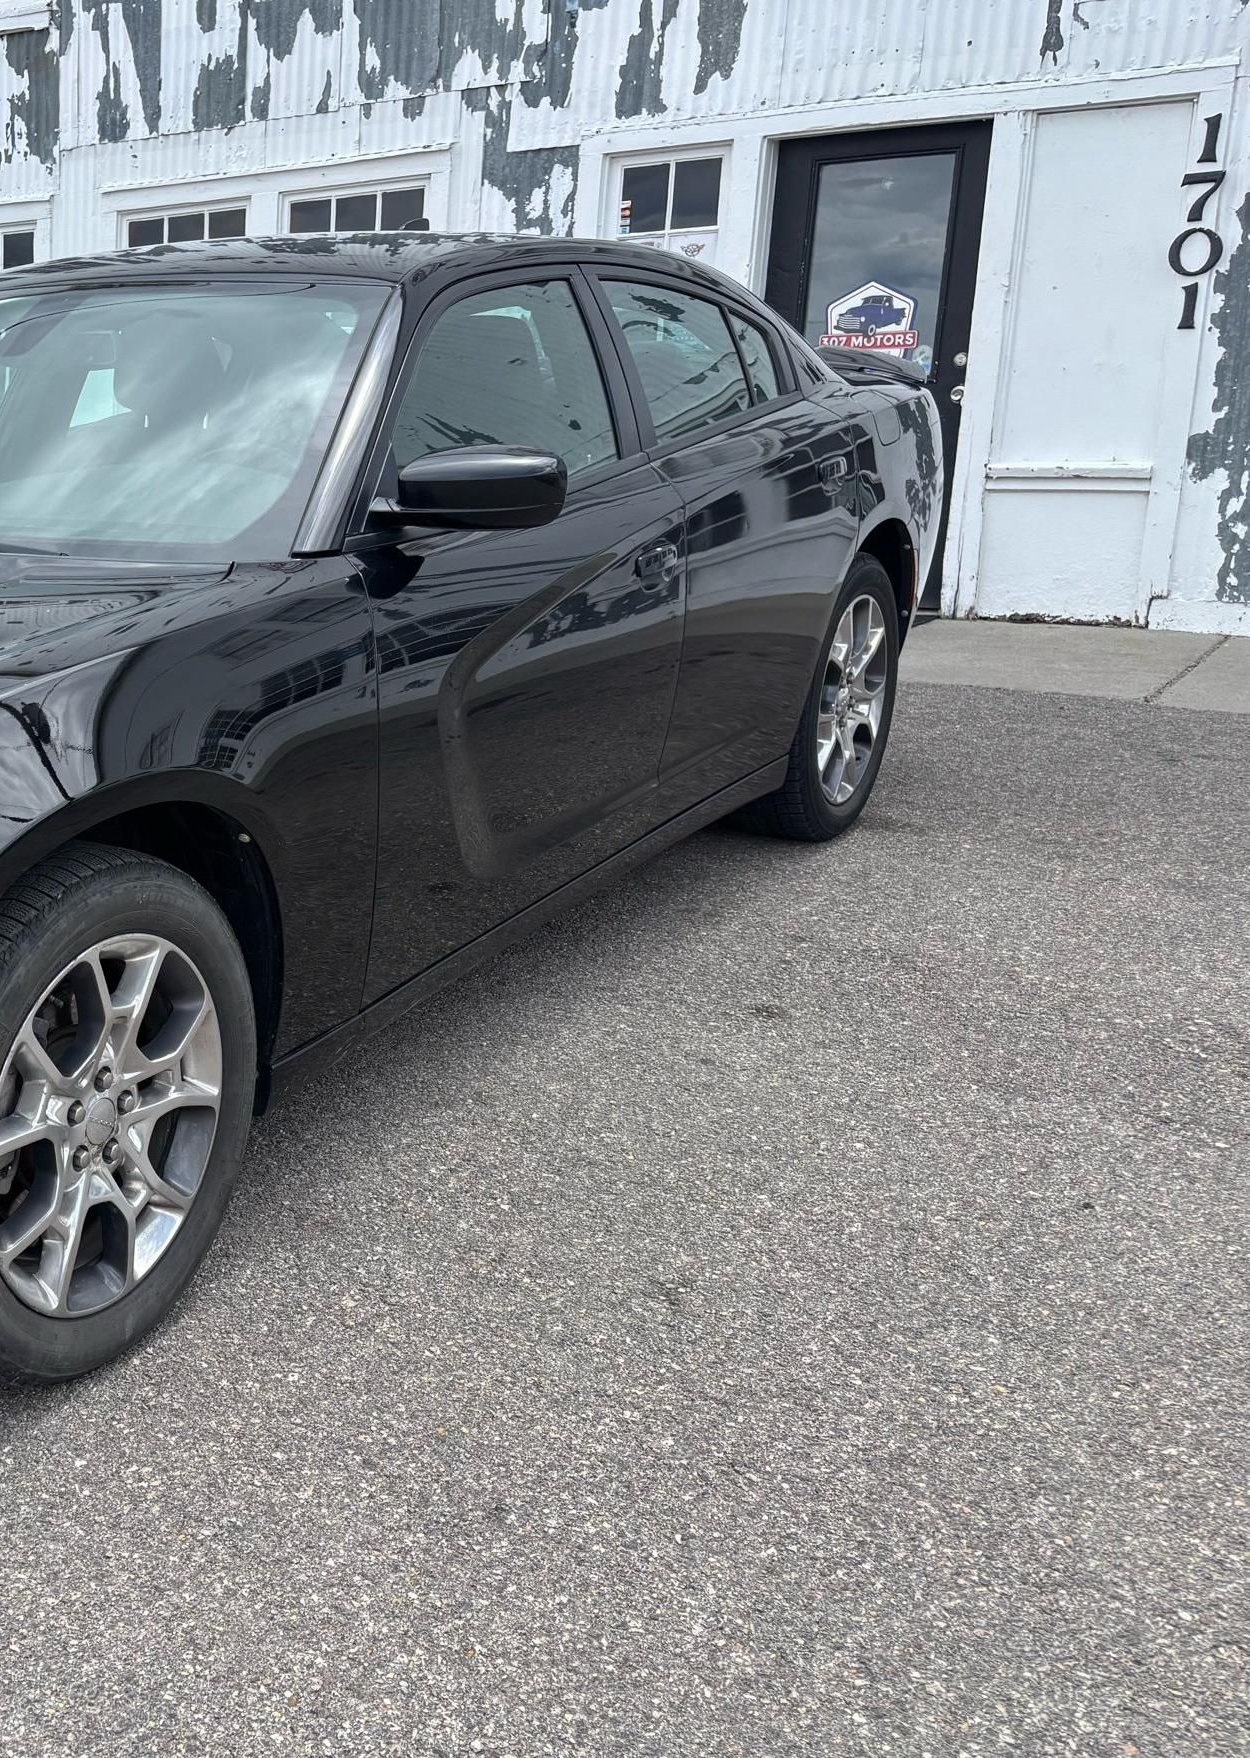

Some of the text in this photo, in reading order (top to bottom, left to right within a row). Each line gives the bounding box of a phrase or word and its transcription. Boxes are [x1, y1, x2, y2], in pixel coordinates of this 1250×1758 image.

[1168, 112, 1227, 329] 1701
[821, 333, 914, 348] 307 MOTORS
